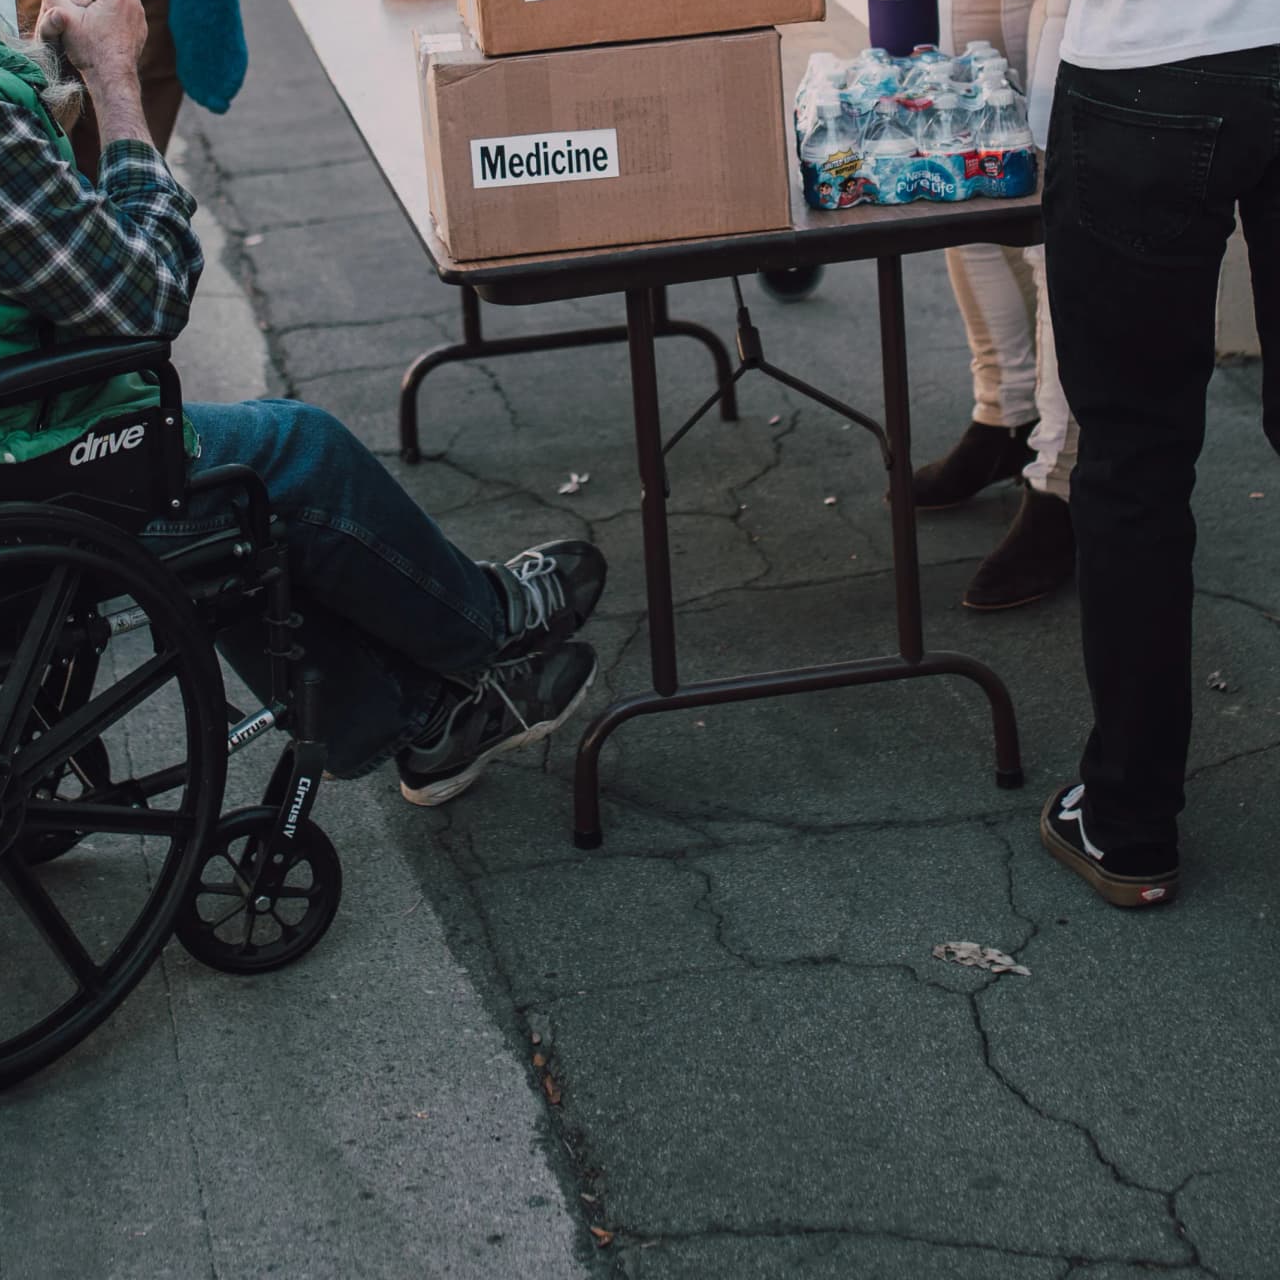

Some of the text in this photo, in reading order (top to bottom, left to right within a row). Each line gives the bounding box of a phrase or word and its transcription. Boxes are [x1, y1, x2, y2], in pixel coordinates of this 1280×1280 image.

[479, 139, 609, 180] Medicine
[896, 179, 955, 197] Pure Life
[69, 424, 145, 466] drive
[229, 717, 268, 746] Cirrus
[282, 776, 312, 839] Cirrus IV
